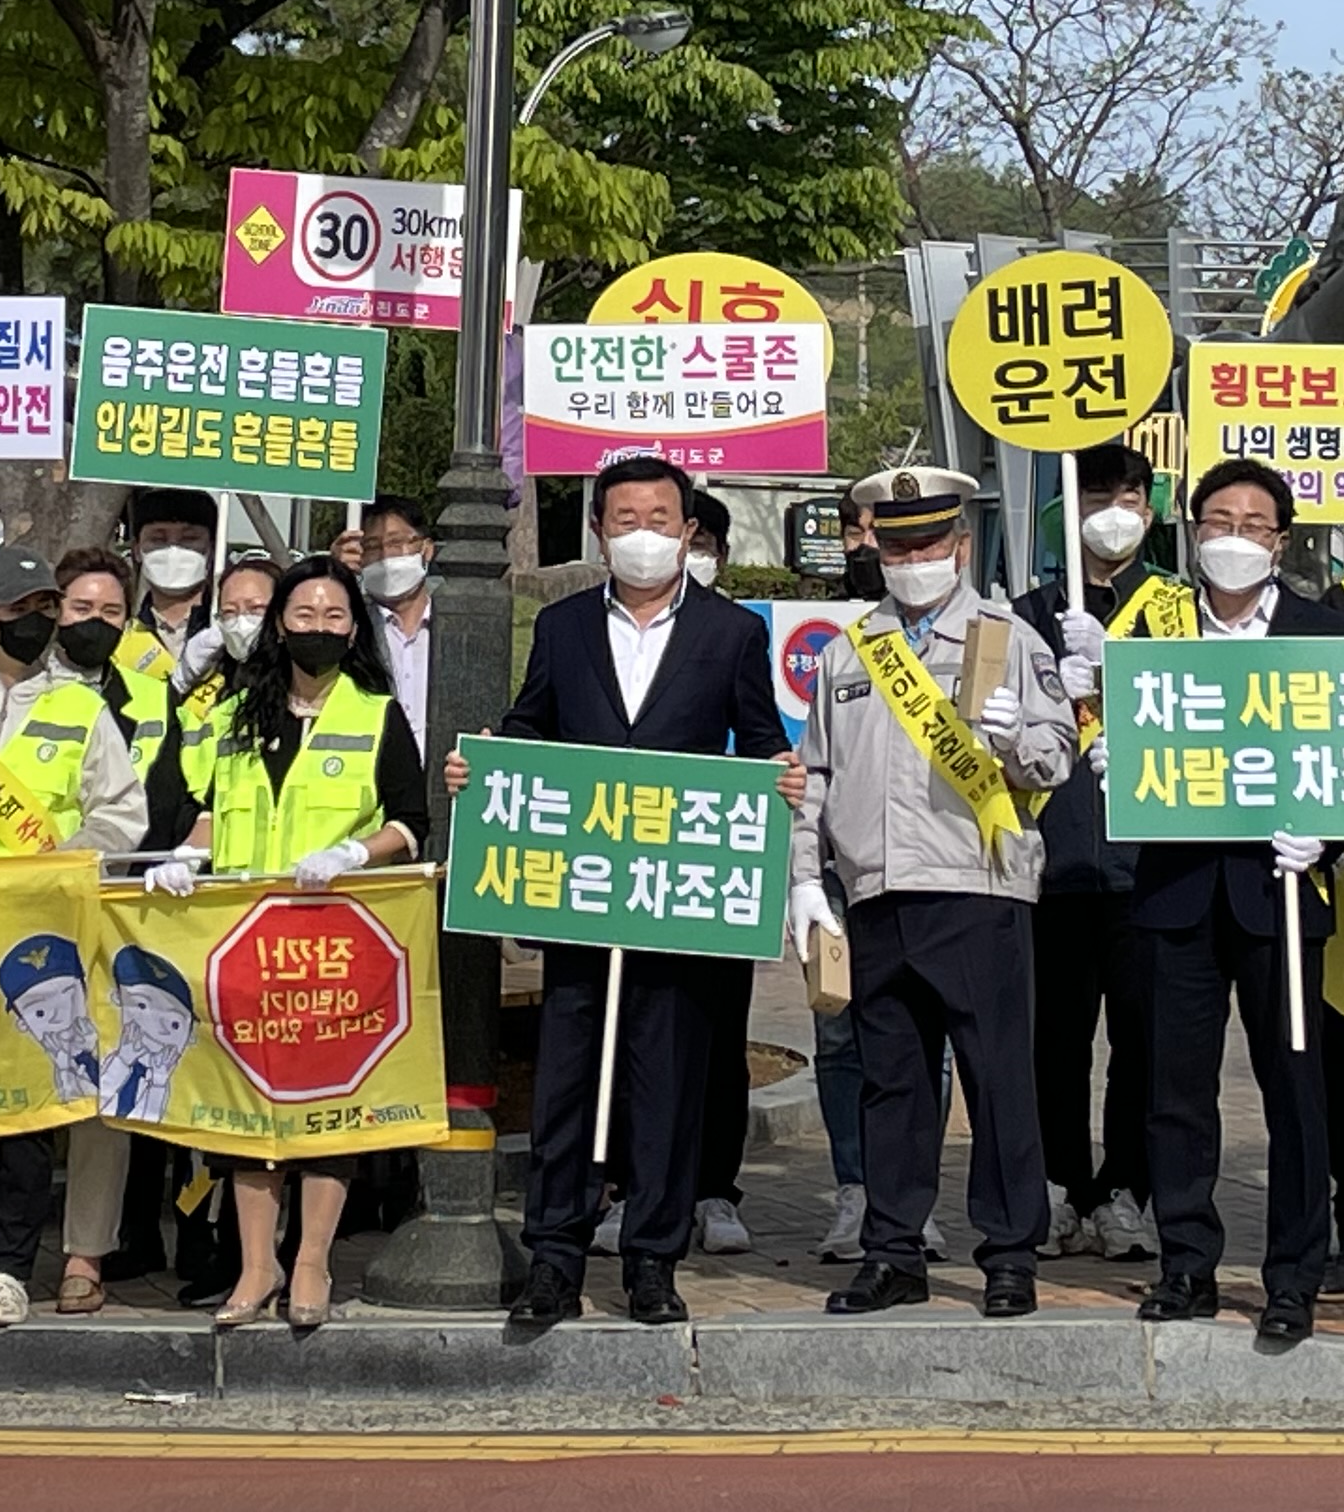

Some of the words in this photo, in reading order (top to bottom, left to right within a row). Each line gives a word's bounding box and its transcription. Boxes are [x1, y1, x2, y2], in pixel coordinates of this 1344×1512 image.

[313, 212, 369, 261] 30
[987, 276, 1123, 347] 배려
[101, 336, 230, 396] 음주운전
[237, 346, 364, 407] 흔들흔들
[550, 334, 668, 383] 안전한
[682, 335, 798, 382] 스쿨존
[567, 392, 616, 419] 우리
[627, 391, 675, 419] 함께
[685, 390, 785, 419] 만들어요
[991, 354, 1128, 425] 운전
[96, 400, 224, 458] 인생길도
[232, 411, 358, 472] 흔들흔들
[669, 448, 725, 465] 진도군
[1222, 424, 1275, 460] 나의
[1133, 670, 1226, 731] 차는
[1135, 747, 1276, 807] 사람은
[482, 770, 571, 835] 차는
[582, 782, 768, 852] 사람조심
[474, 846, 612, 913] 사람은
[626, 857, 763, 926] 차조심
